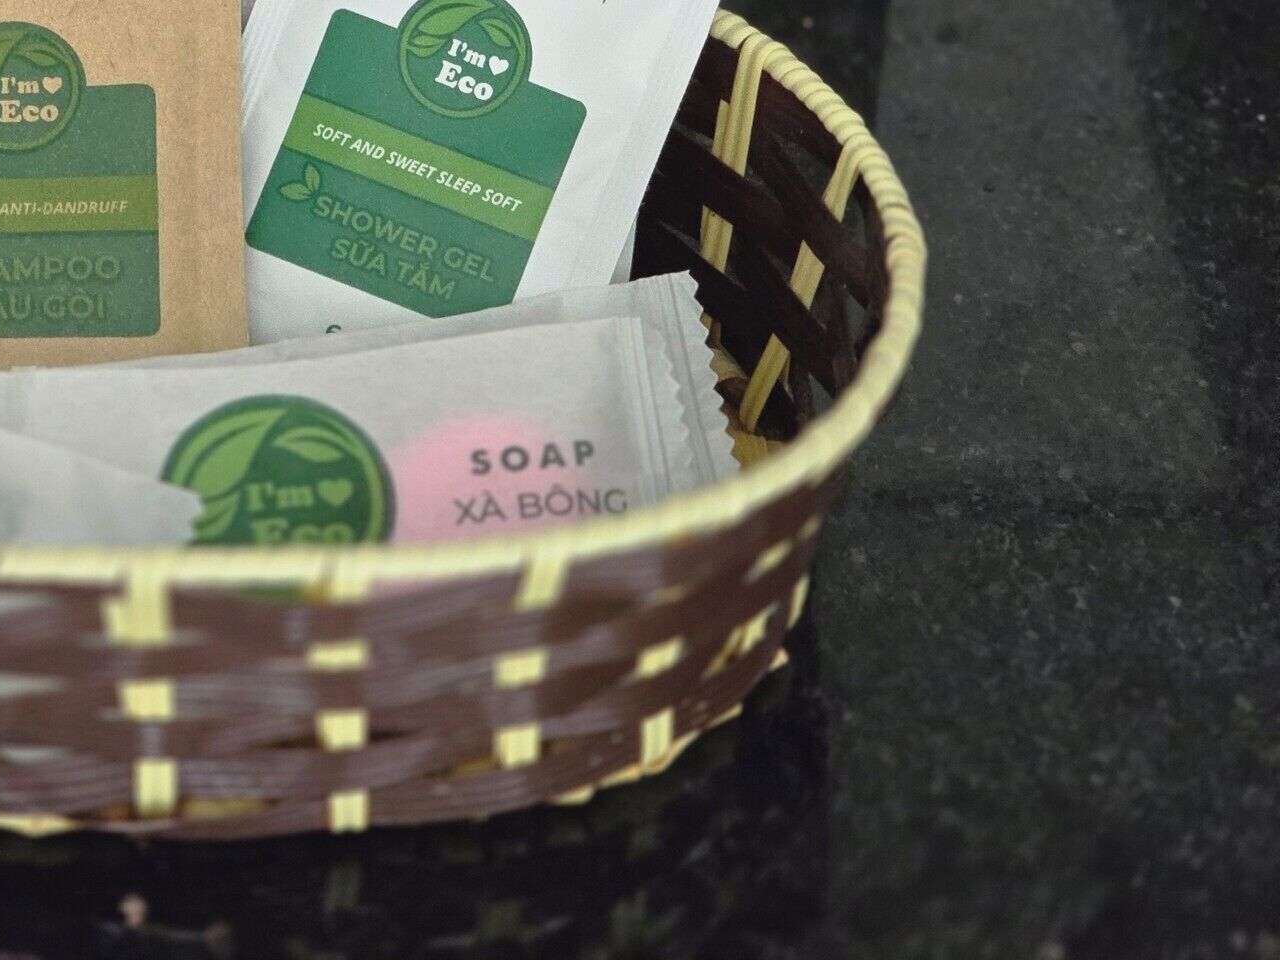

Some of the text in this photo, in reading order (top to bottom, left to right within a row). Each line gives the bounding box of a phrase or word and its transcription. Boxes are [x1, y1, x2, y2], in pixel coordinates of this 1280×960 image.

[447, 38, 486, 69] I'm
[1, 76, 40, 94] I'm
[435, 60, 494, 101] Eco
[0, 99, 59, 123] Eco
[313, 123, 523, 213] SOFT AND SWEET SLEEP SOFT
[314, 196, 494, 283] SHOWER GEL
[471, 440, 595, 476] SOAP
[453, 483, 629, 525] XÀ BÔNG
